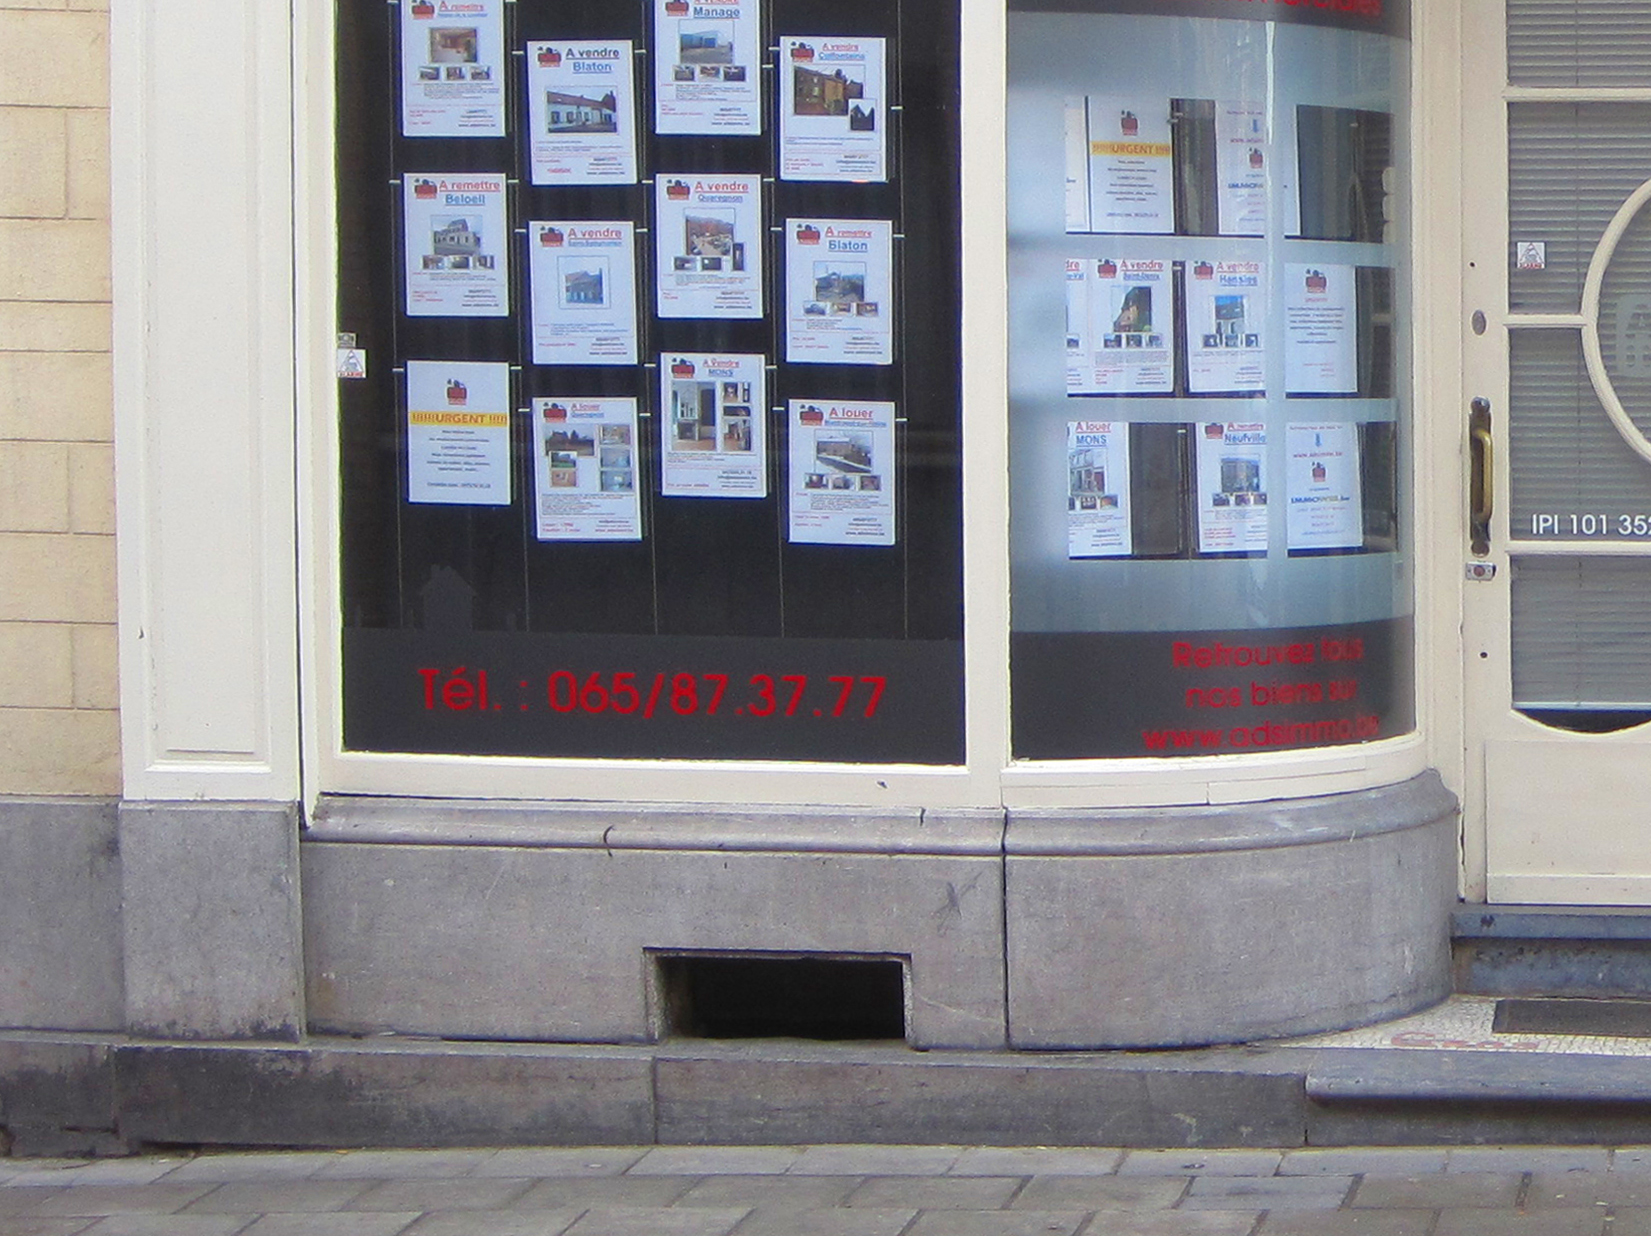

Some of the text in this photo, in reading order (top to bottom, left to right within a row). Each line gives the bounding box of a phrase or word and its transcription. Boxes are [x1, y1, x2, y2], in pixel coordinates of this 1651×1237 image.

[439, 0, 447, 11] A
[566, 47, 619, 58] A vendre
[573, 62, 612, 71] Blaton
[439, 180, 500, 190] A remettre
[695, 182, 748, 191] A vendre
[568, 228, 622, 238] A vendre
[825, 226, 834, 237] A
[828, 240, 868, 250] Blaton
[1121, 260, 1163, 269] A vendre
[1226, 262, 1259, 271] vendre
[830, 408, 874, 417] A louer
[1076, 422, 1111, 431] A louer
[1076, 434, 1107, 444] MONS
[1532, 514, 1558, 534] IPI
[1570, 514, 1608, 534] 101
[1172, 640, 1315, 669] Retrouvez
[417, 666, 500, 710] Tél.
[547, 670, 886, 719] 065/87.37.77
[1186, 685, 1243, 709] nos
[1251, 681, 1323, 707] biens
